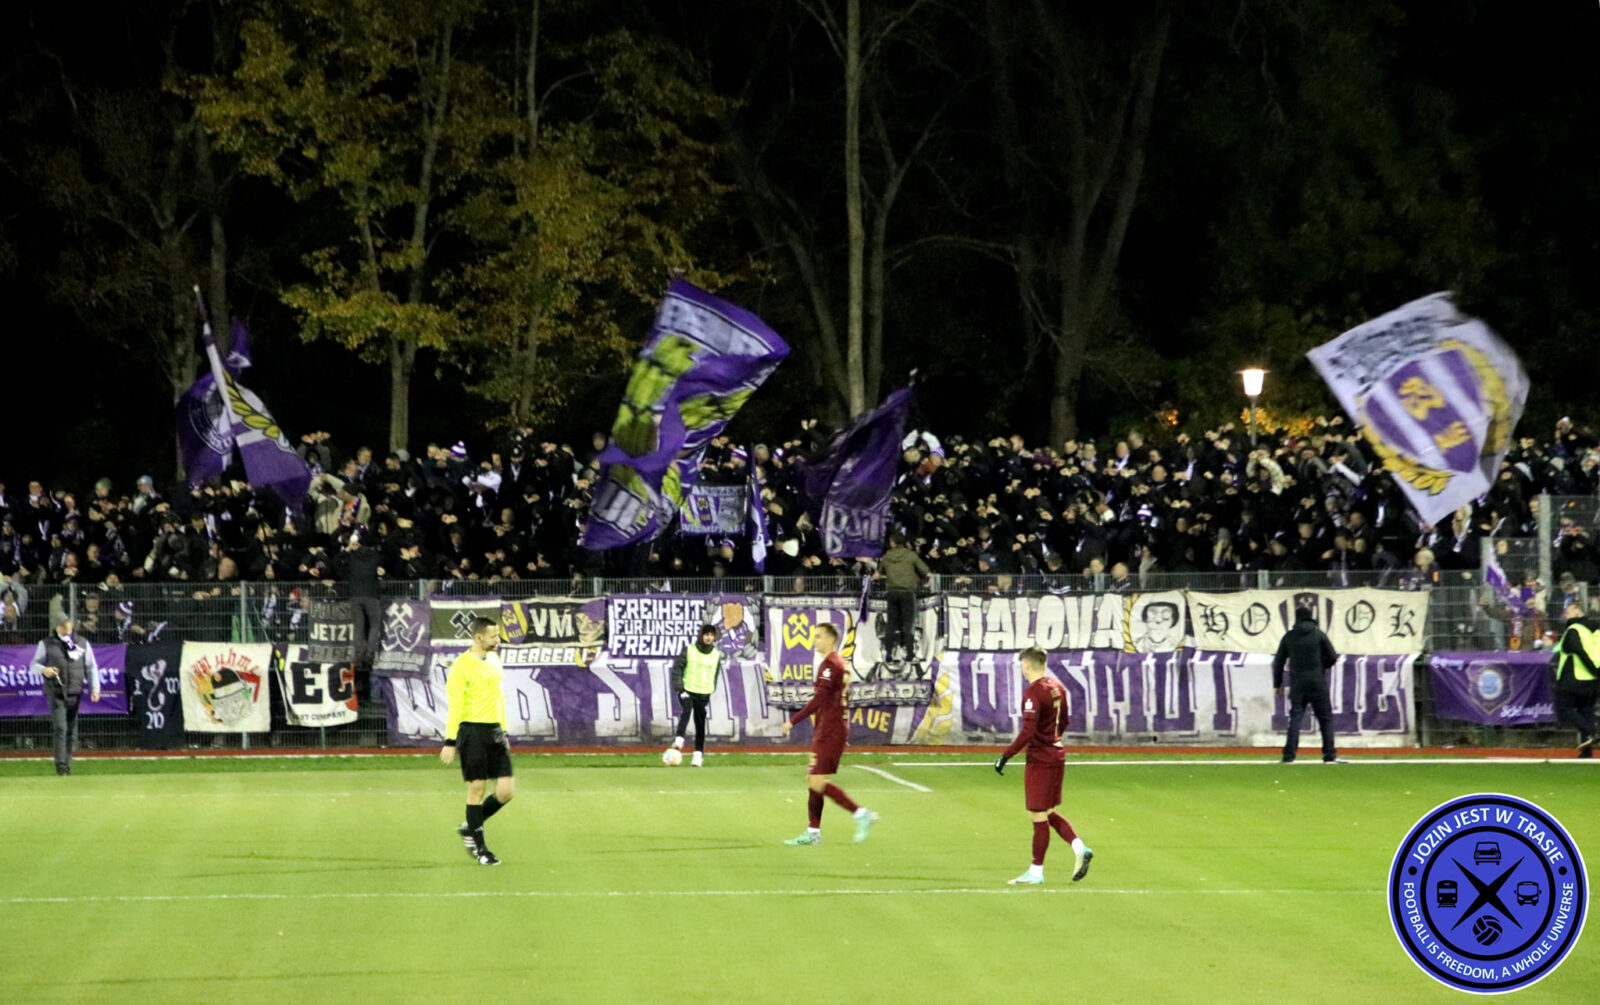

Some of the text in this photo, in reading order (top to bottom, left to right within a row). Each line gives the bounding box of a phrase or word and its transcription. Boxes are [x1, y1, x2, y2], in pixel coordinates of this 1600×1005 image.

[613, 599, 704, 620] FREIHEIT
[529, 608, 573, 638] VM
[611, 635, 698, 656] FREUND
[290, 662, 354, 704] EC
[782, 664, 813, 680] AUE
[388, 653, 559, 743] WR
[767, 683, 931, 701] ERZIGADE
[851, 707, 892, 733] AUE
